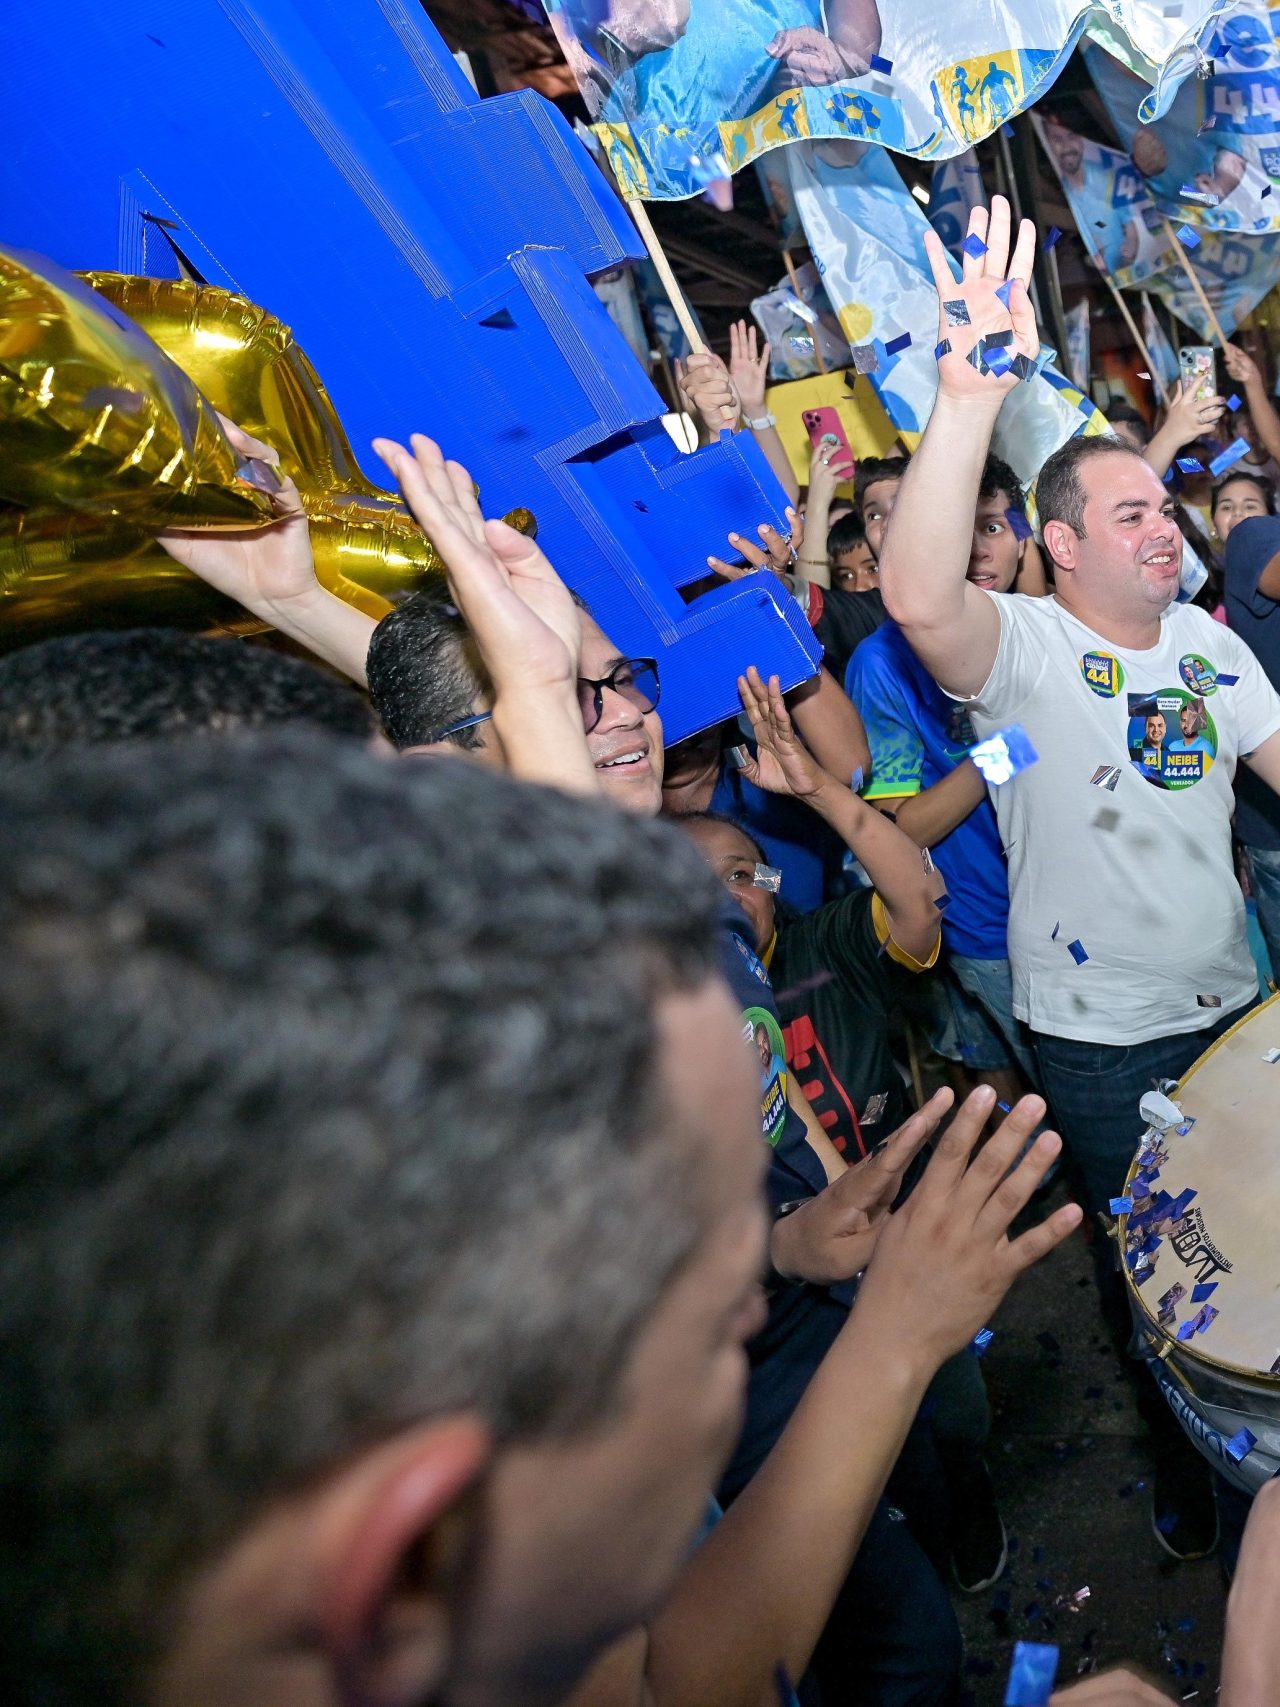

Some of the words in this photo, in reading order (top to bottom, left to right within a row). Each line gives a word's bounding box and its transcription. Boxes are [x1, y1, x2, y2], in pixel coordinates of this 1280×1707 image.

[1087, 668, 1110, 686] 44
[1167, 754, 1199, 766] NEIBE
[1164, 766, 1201, 777] 44.444
[1201, 1231, 1234, 1270] INSTRUMENTOS
